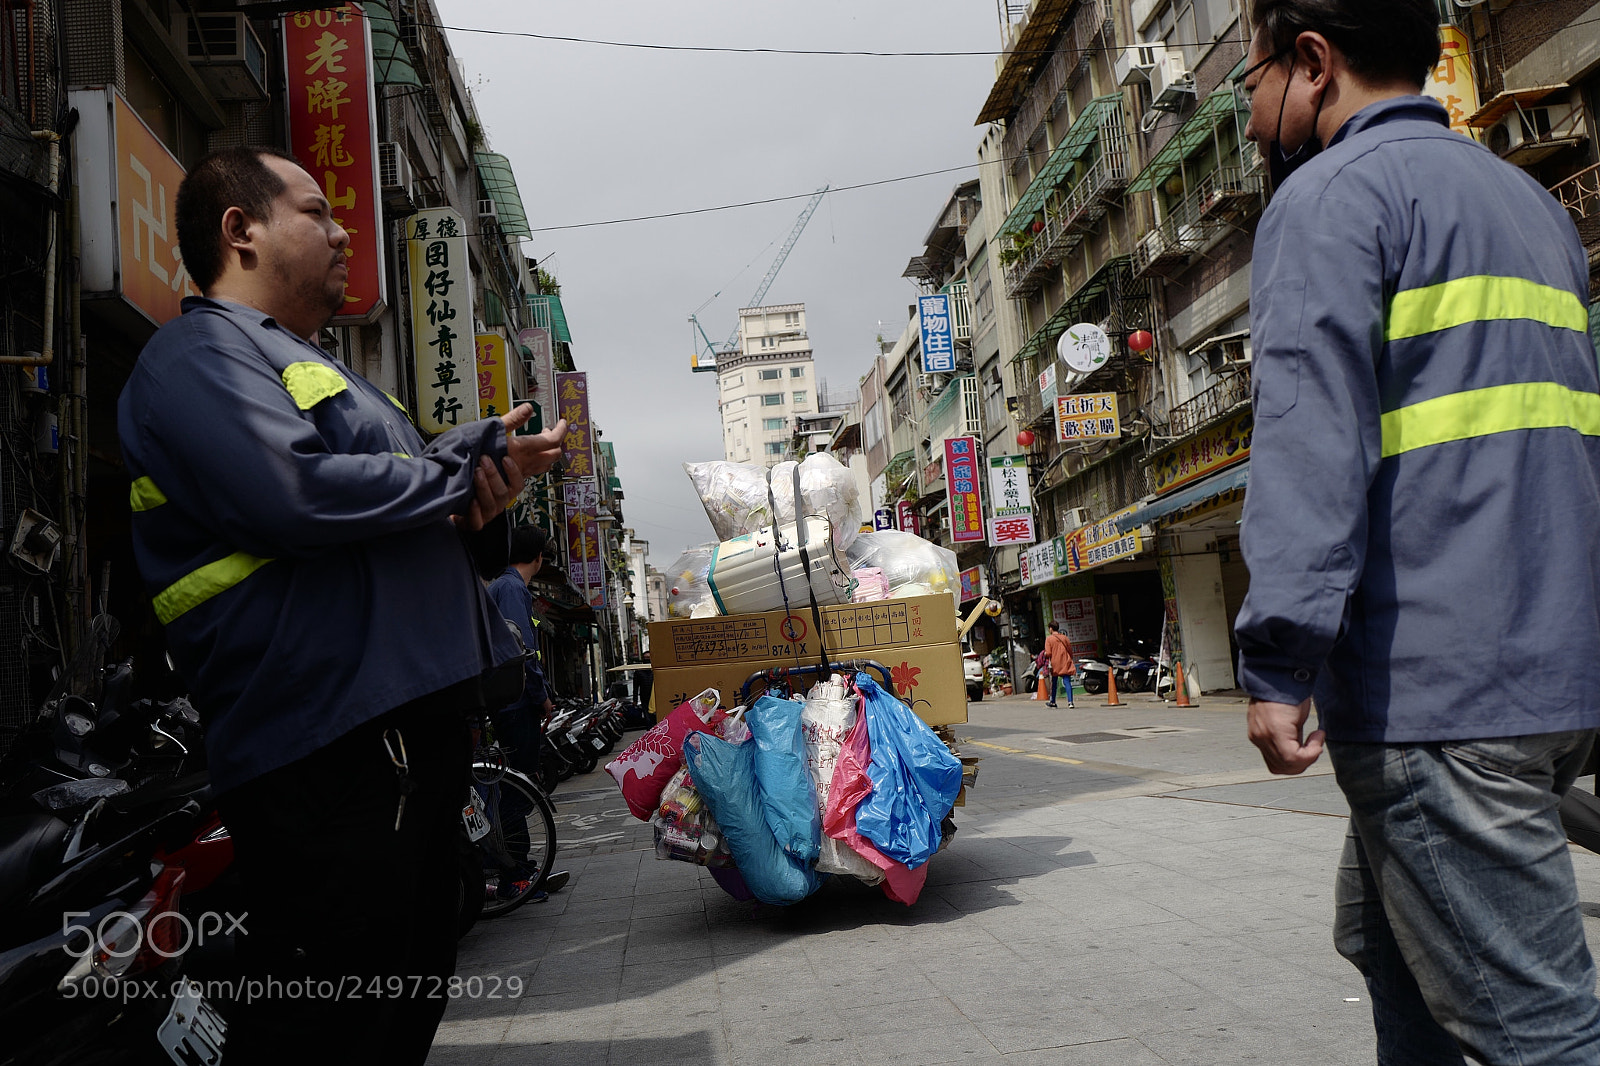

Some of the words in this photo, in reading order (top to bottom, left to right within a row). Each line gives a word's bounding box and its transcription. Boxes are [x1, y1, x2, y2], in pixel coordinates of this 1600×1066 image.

[920, 297, 951, 371] 寵物住宿
[1061, 396, 1112, 415] 五折天
[1064, 418, 1115, 437] 歡喜購
[951, 440, 973, 493] 第一寵物
[1002, 467, 1020, 509] 松本藥局
[995, 518, 1031, 542] 藥
[841, 616, 854, 624] 台中
[910, 604, 924, 638] 可回收
[772, 644, 791, 656] 874
[800, 643, 808, 654] X
